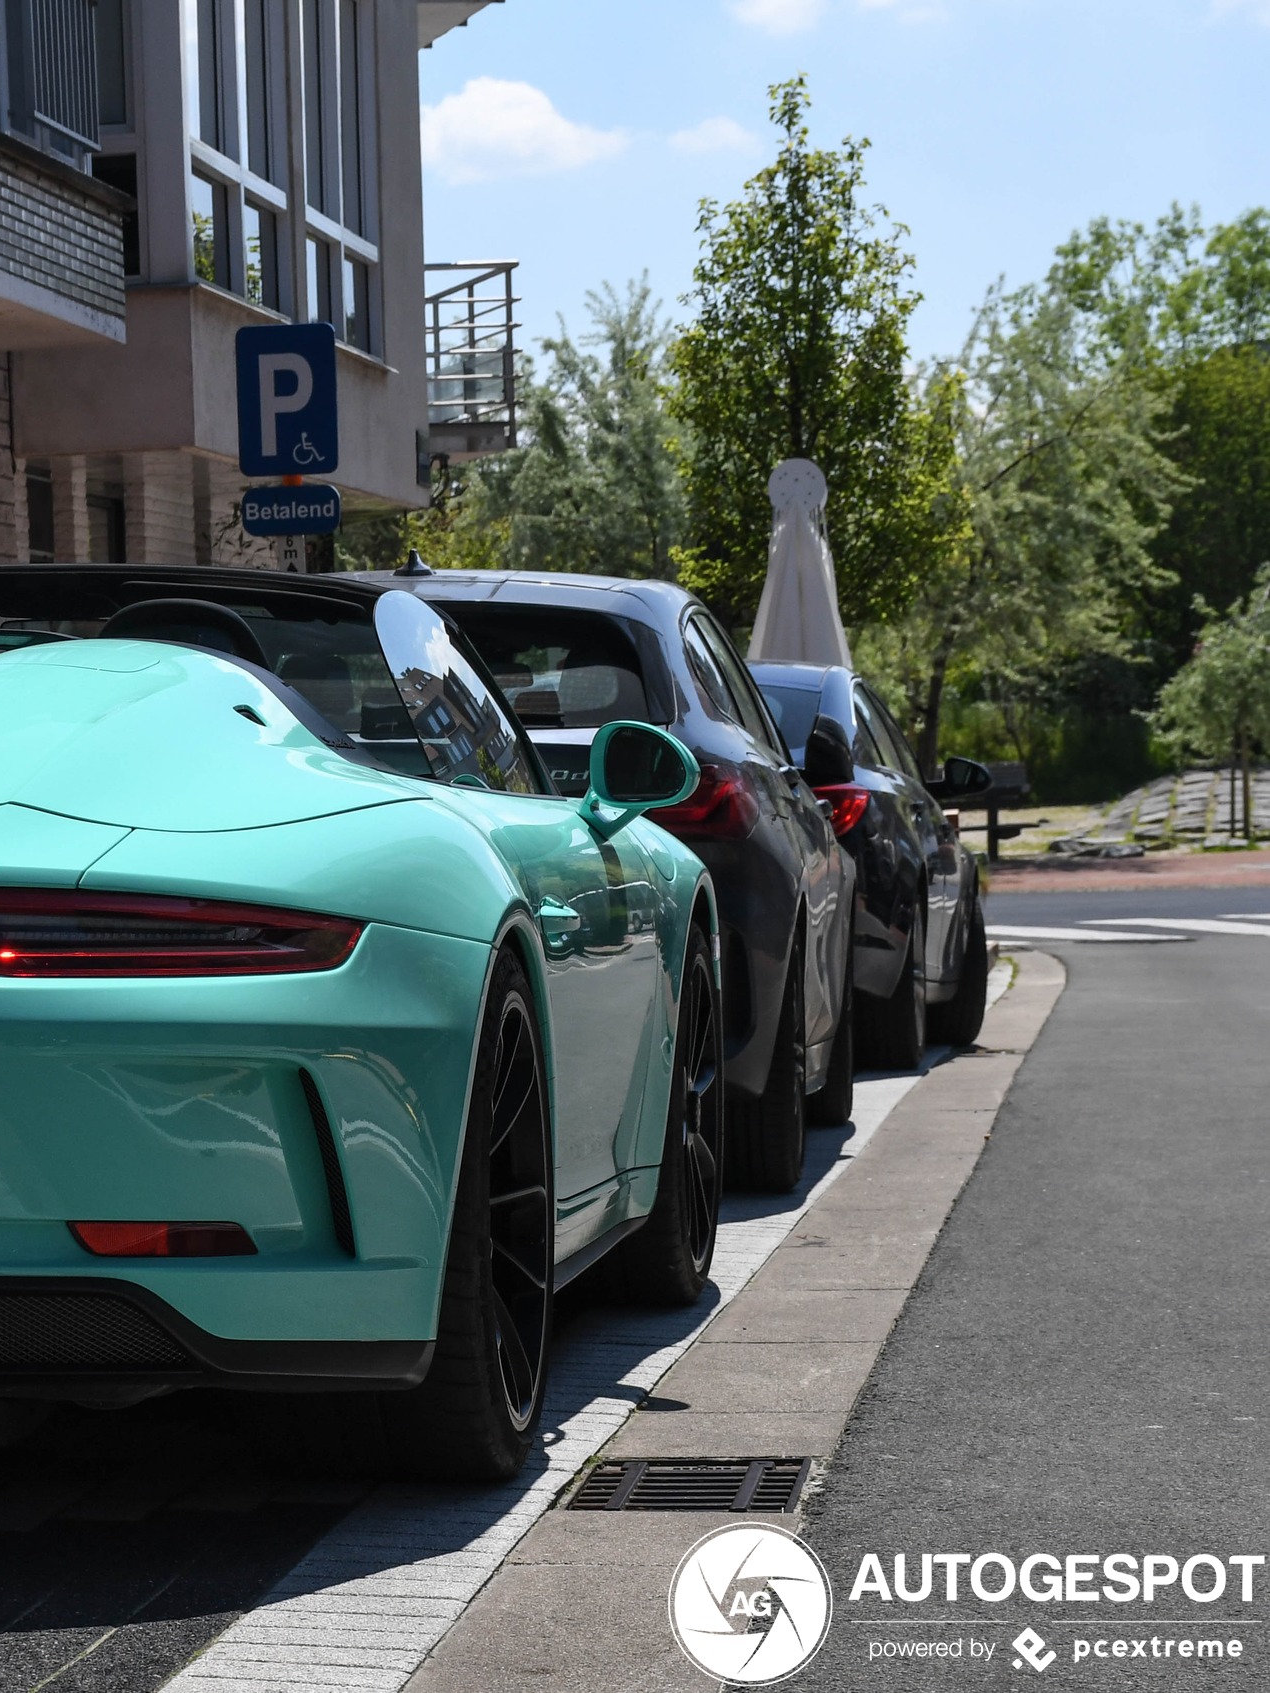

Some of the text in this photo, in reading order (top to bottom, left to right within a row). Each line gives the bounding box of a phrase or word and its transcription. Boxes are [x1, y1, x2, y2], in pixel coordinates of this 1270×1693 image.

[258, 353, 313, 457] P
[245, 500, 335, 521] Betalend
[284, 549, 298, 559] m
